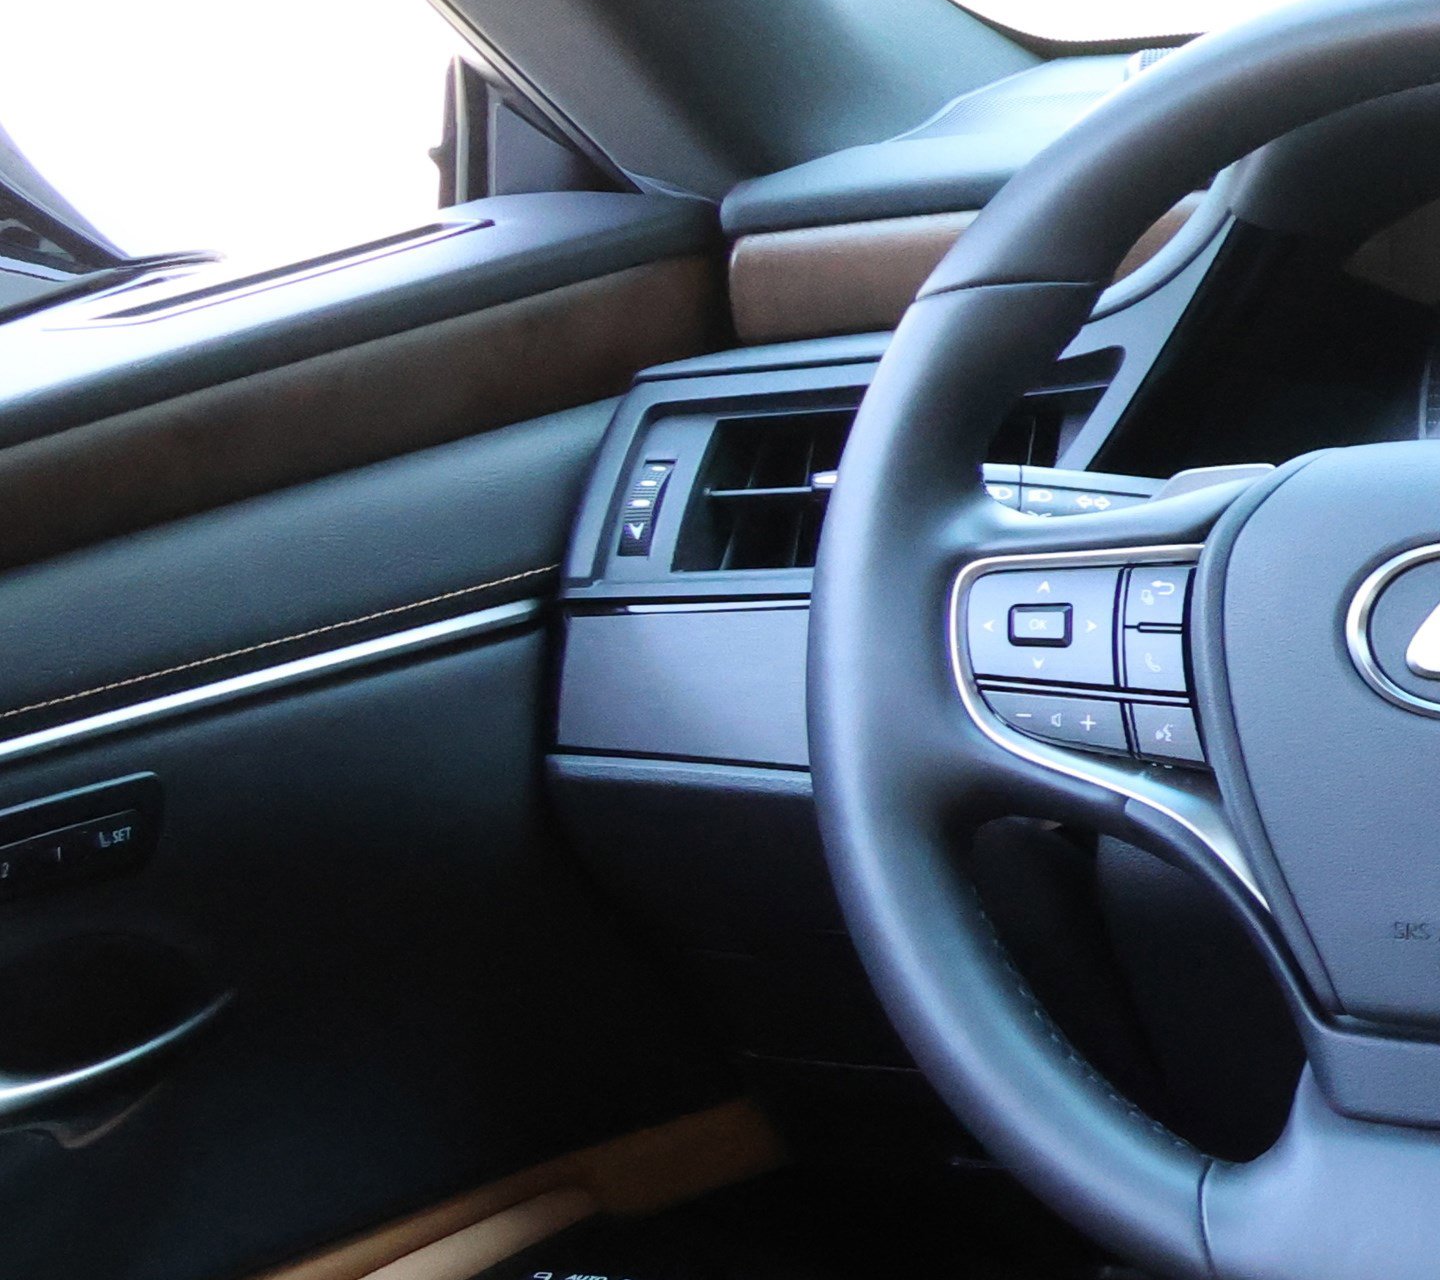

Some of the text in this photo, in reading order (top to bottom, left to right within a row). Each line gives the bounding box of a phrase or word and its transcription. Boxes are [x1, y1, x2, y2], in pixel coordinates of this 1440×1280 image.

[1028, 618, 1047, 631] OK
[112, 826, 132, 843] SET
[1393, 921, 1431, 940] SRS
